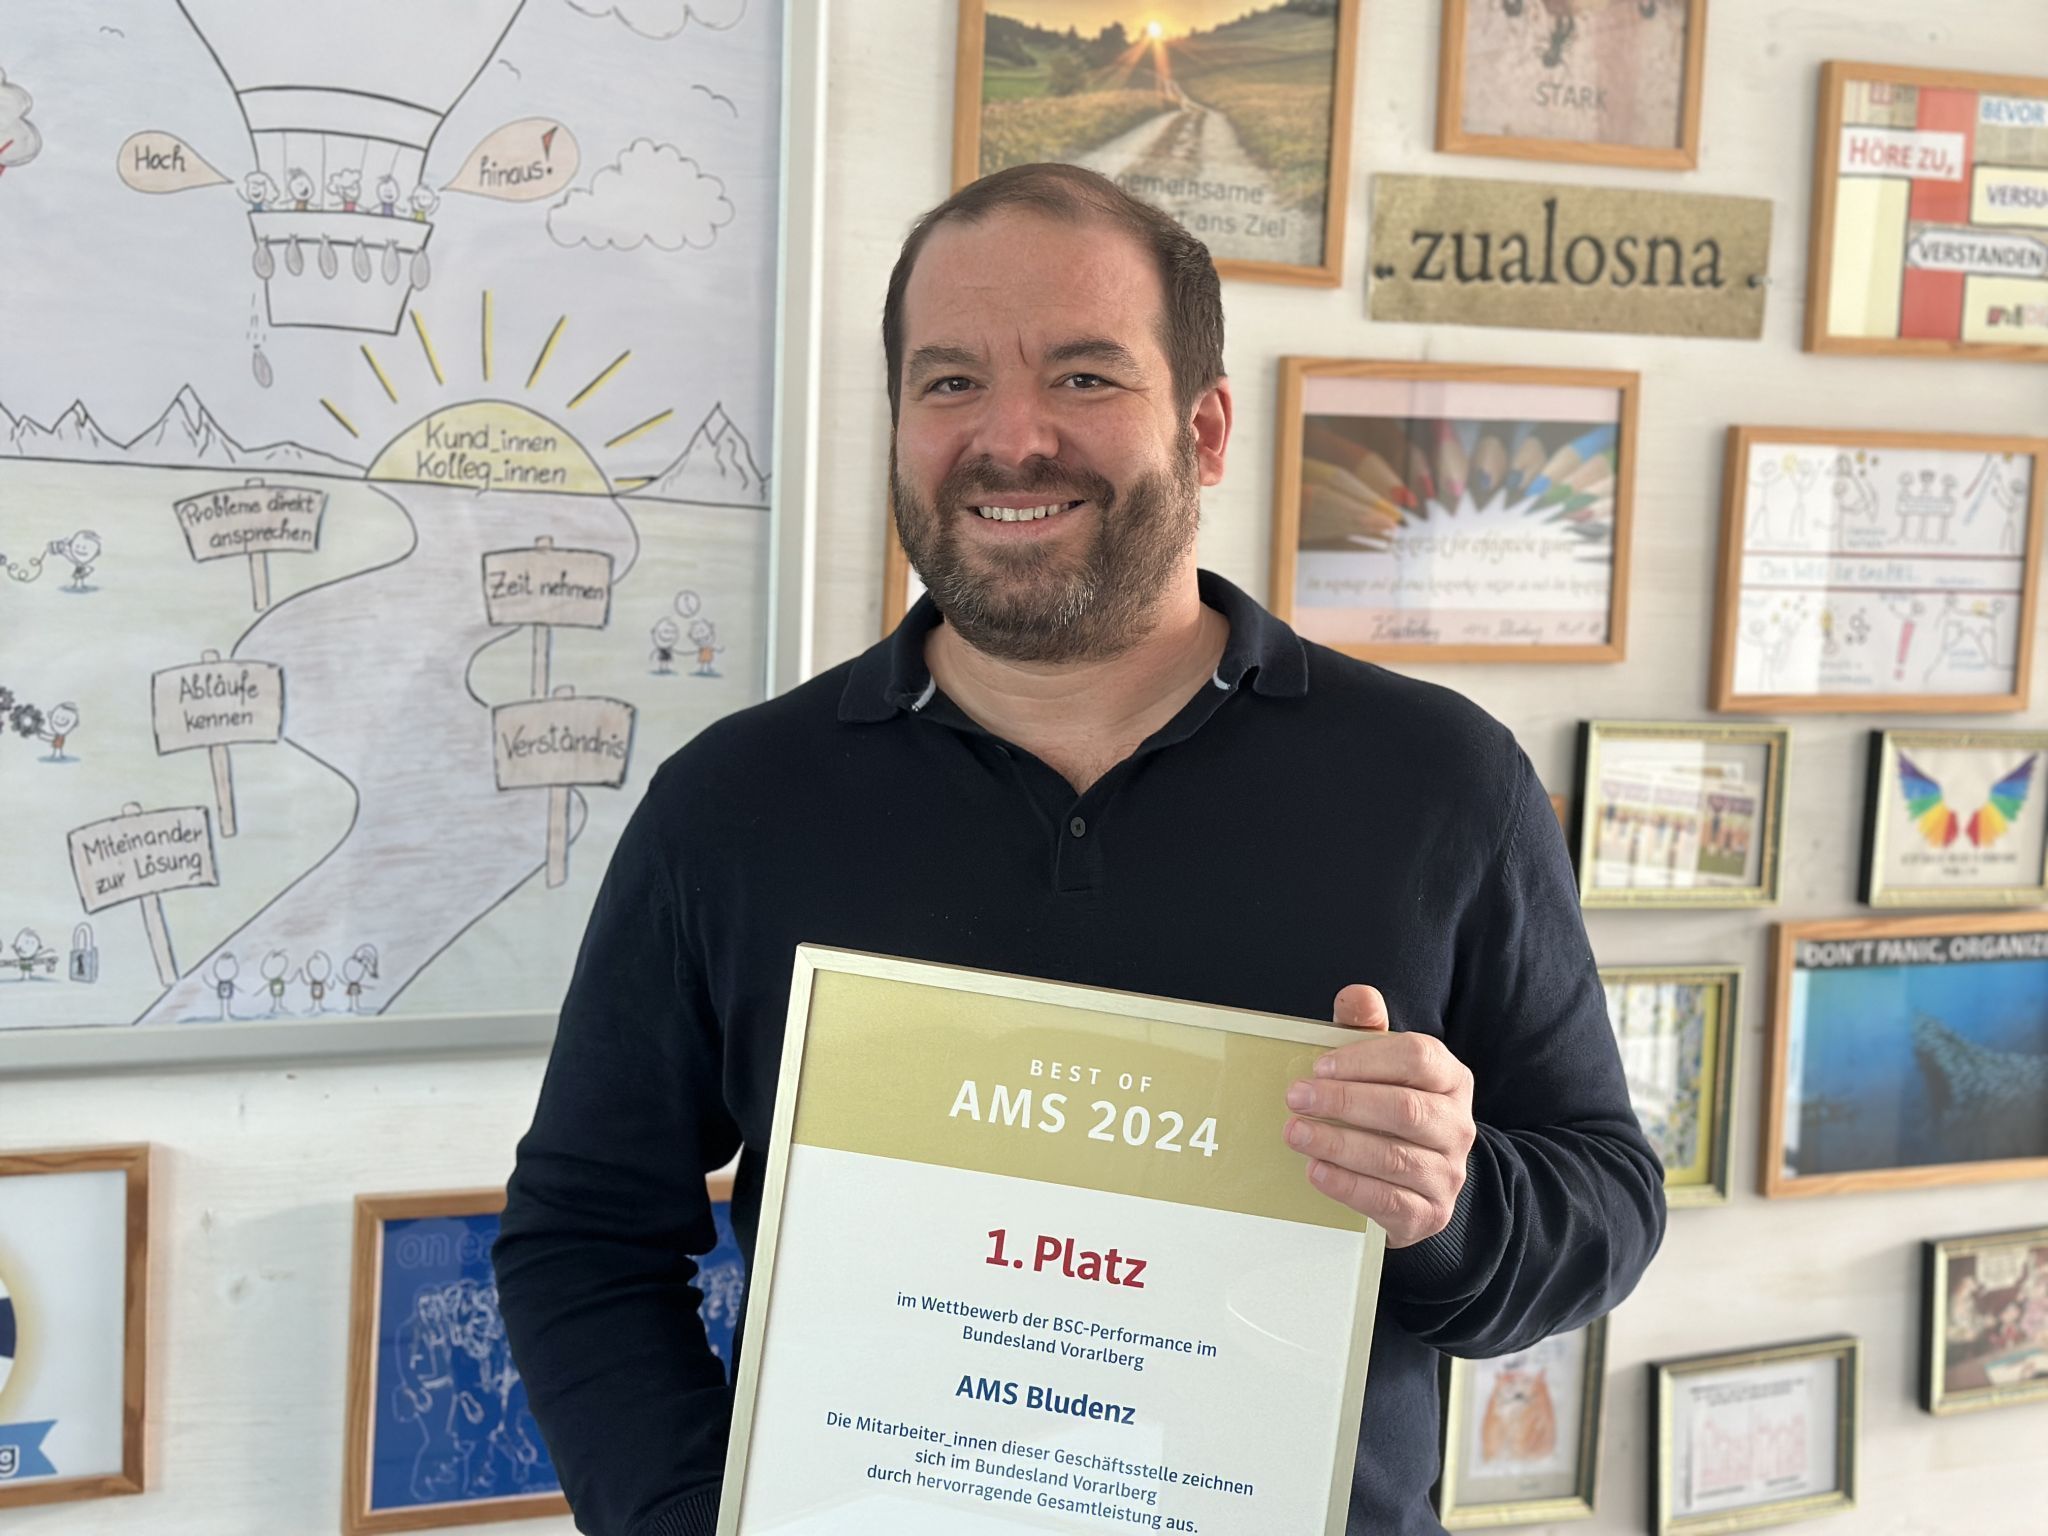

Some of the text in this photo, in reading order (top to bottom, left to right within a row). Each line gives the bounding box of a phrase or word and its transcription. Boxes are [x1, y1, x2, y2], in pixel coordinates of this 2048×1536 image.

[1535, 80, 1609, 112] STARK
[1982, 101, 2044, 124] BEVOR
[135, 145, 186, 173] Hoch
[480, 126, 559, 187] hinaus!
[1849, 135, 1954, 175] HÖRE ZU,
[1244, 212, 1288, 239] Ziel
[1919, 240, 2043, 269] VERSTANDEN
[426, 419, 557, 453] Kund_innen
[416, 450, 566, 497] Kolleg_innen
[180, 491, 317, 527] Probleme direkt
[209, 517, 312, 552] ansprechen
[488, 570, 605, 600] Zeit nehmen
[179, 669, 260, 706] Abläufe
[184, 709, 254, 733] kennen
[502, 724, 627, 760] Verständnis
[82, 820, 203, 866] Miteinander
[95, 852, 203, 896] zur Lösung
[1802, 940, 1875, 968] DON'T
[1030, 1059, 1153, 1093] BEST OF
[949, 1079, 1219, 1158] AMS 2024
[985, 1228, 1148, 1289] 1. Platz
[896, 1291, 1218, 1358] im Wettbewerb der BSC-Performance im
[962, 1325, 1145, 1372] Bundesland Vorarlberg
[955, 1375, 1136, 1426] AMS Bludenz
[826, 1411, 1255, 1496] Die Mitarbeiter_innen dieser Geschäftsstelle zeichnen
[914, 1448, 1158, 1506] sich im Bundesland Vorarlberg
[866, 1464, 1199, 1535] durch hervorragende Gesamtleistung aus.
